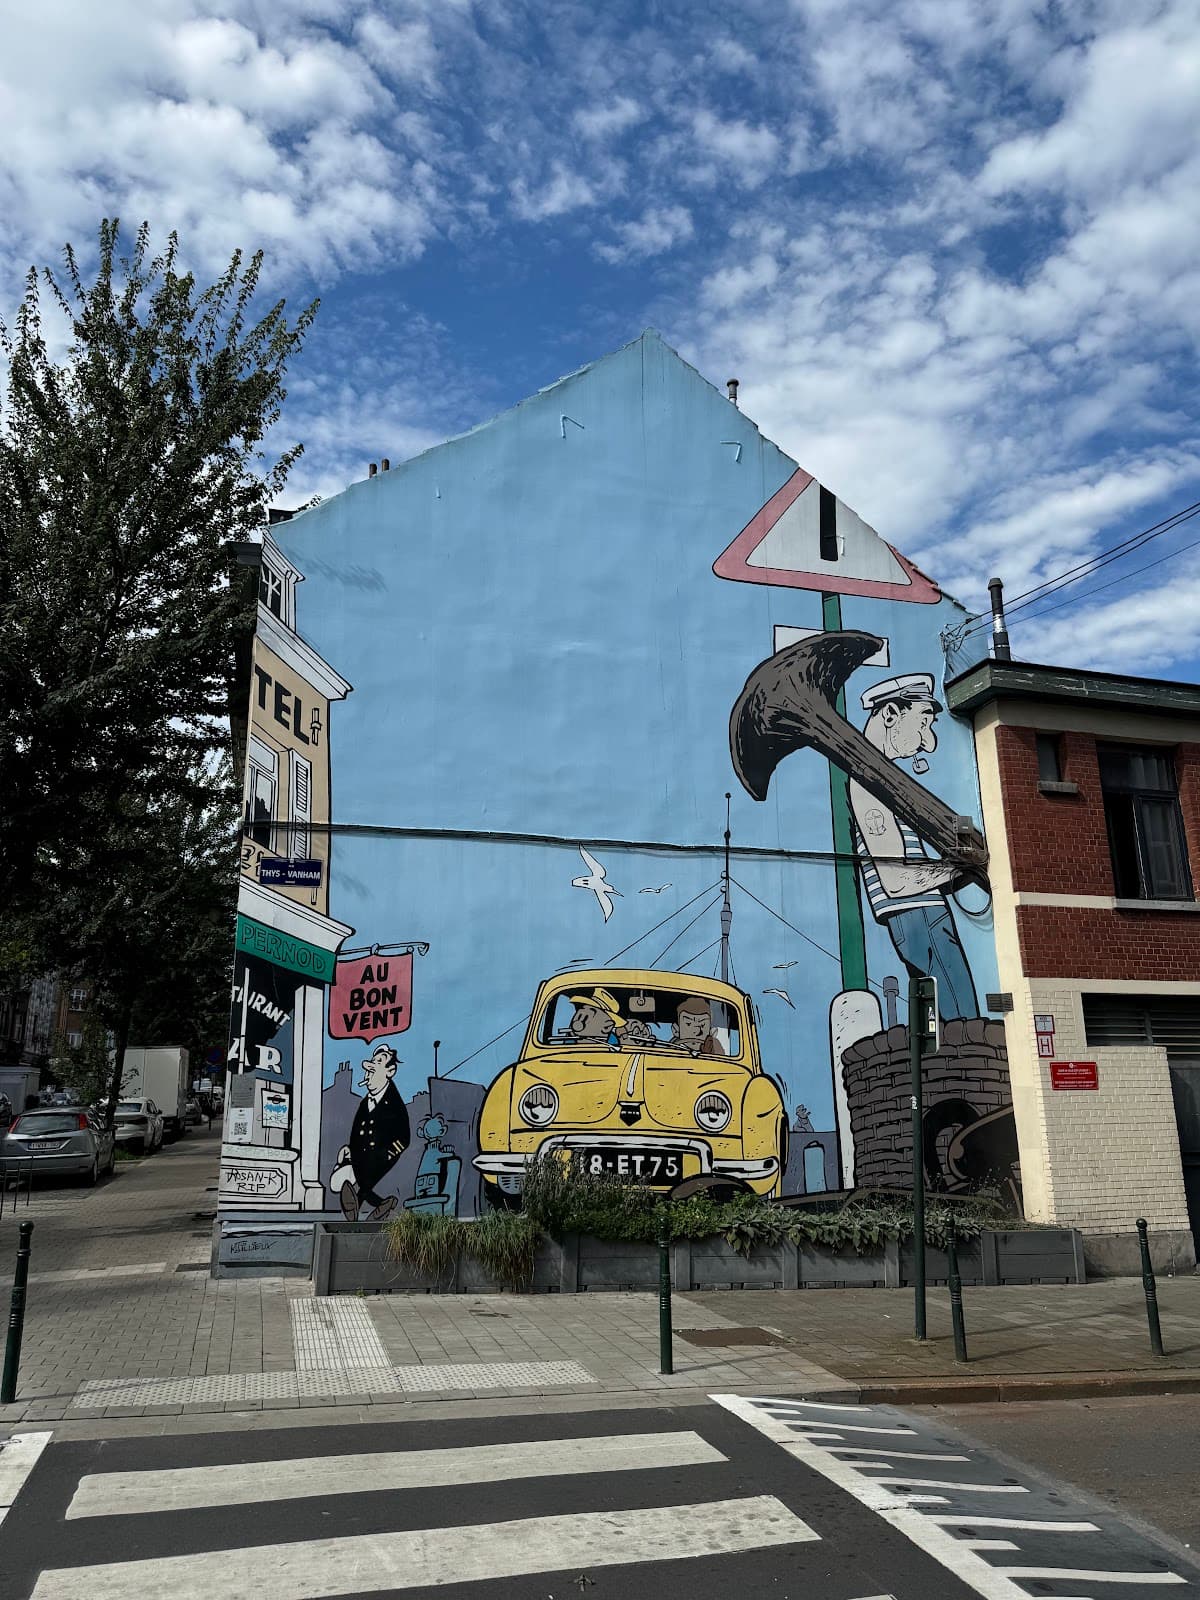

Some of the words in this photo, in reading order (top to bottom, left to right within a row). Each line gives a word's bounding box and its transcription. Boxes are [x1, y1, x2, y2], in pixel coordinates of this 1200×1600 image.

[254, 663, 310, 745] TEL
[261, 869, 281, 878] THYS
[287, 870, 321, 880] VANHAM
[241, 922, 326, 974] PERNOD
[360, 961, 390, 985] AU
[349, 984, 398, 1011] BON
[343, 1006, 403, 1033] VENT
[1040, 1038, 1050, 1054] H
[236, 1182, 266, 1193] RIP
